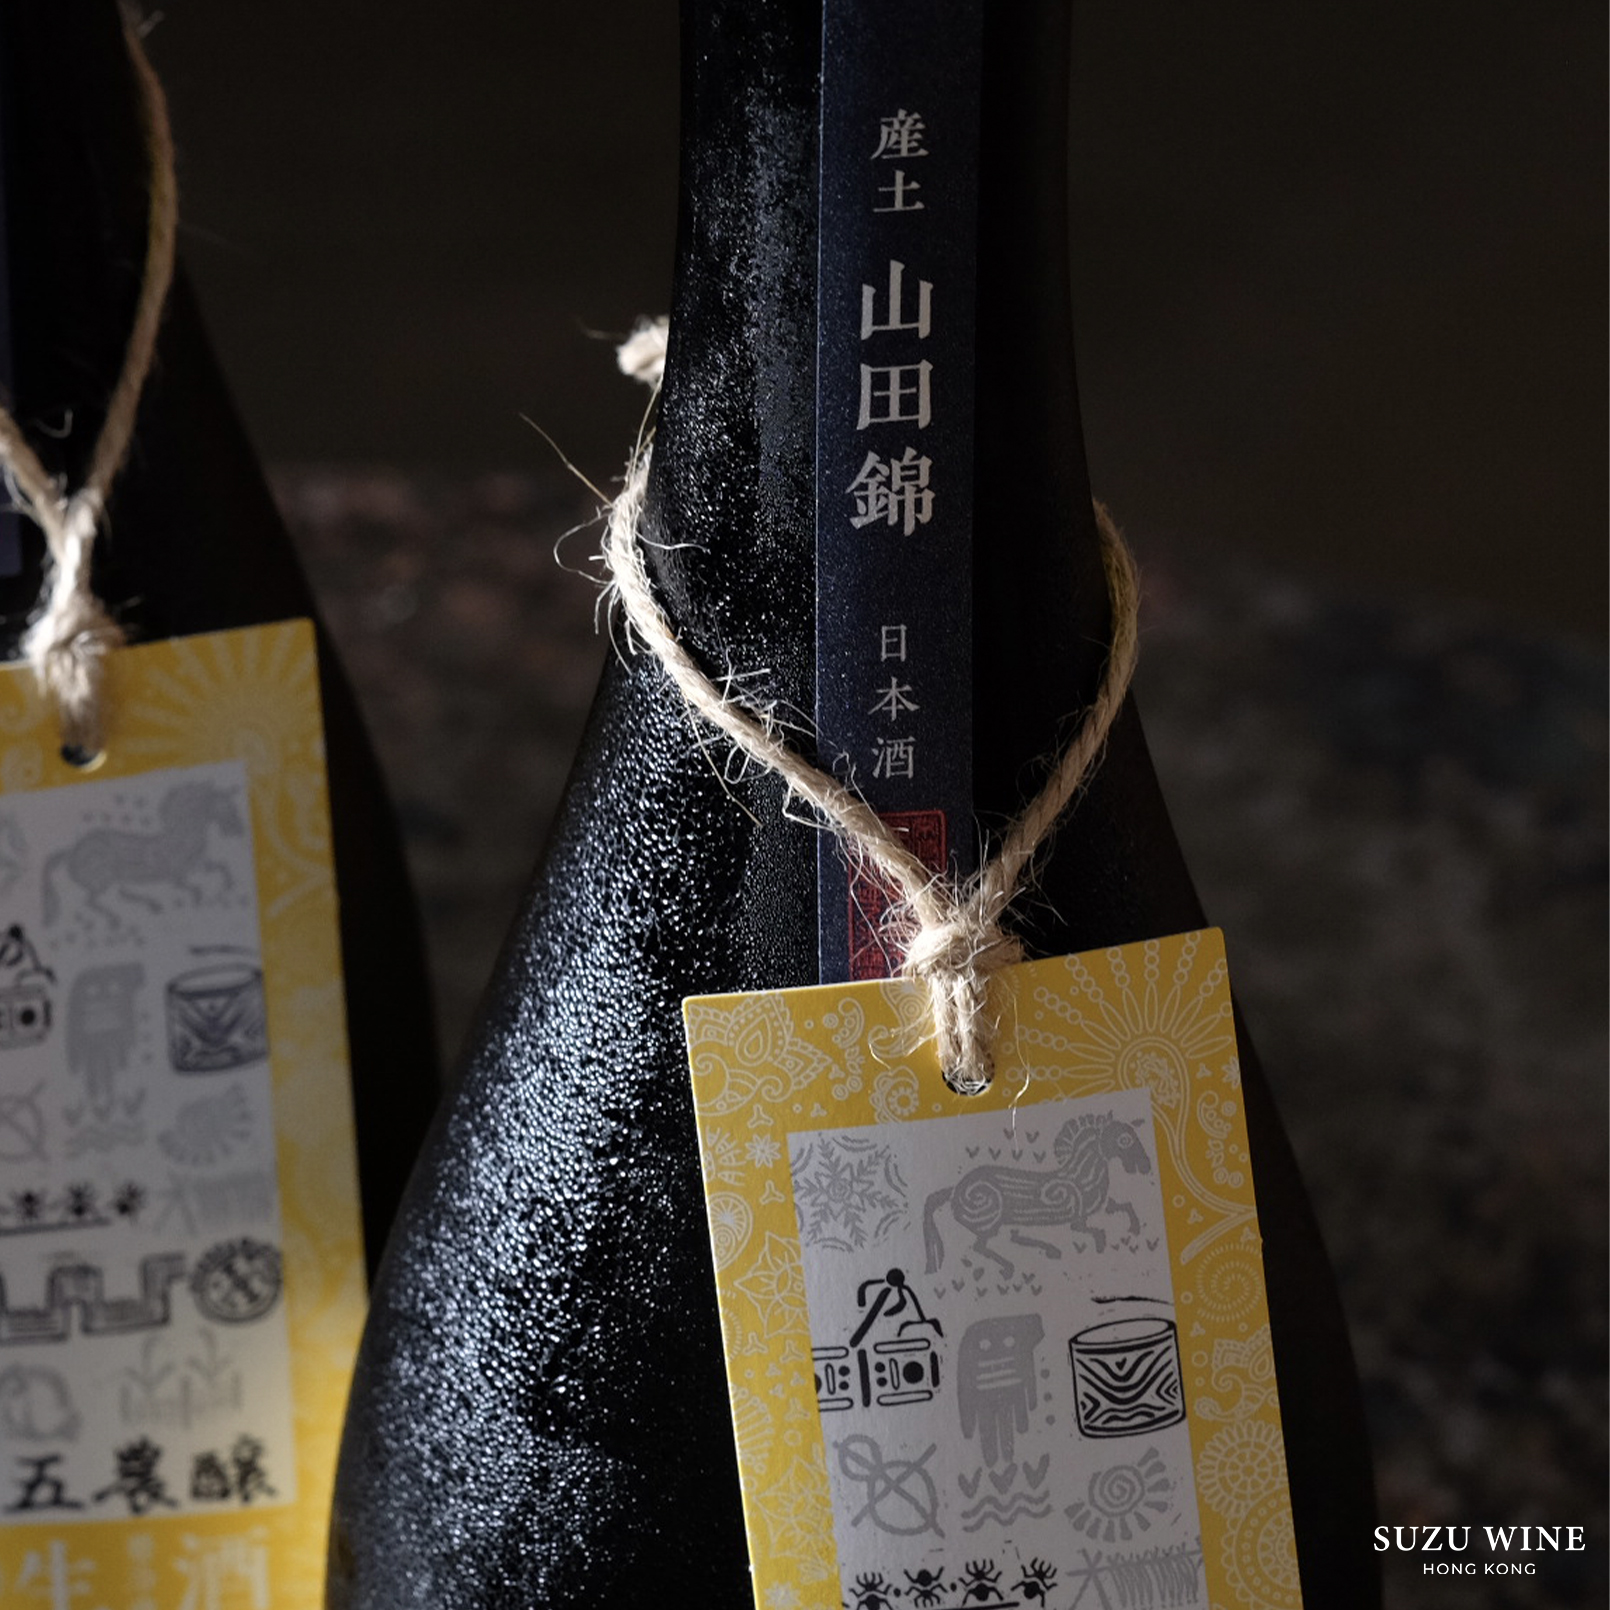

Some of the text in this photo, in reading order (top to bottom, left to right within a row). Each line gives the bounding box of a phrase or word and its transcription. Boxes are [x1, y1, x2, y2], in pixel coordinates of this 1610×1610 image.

[870, 107, 930, 214] 産土
[845, 259, 936, 537] 山田錦
[867, 623, 920, 780] 日本酒
